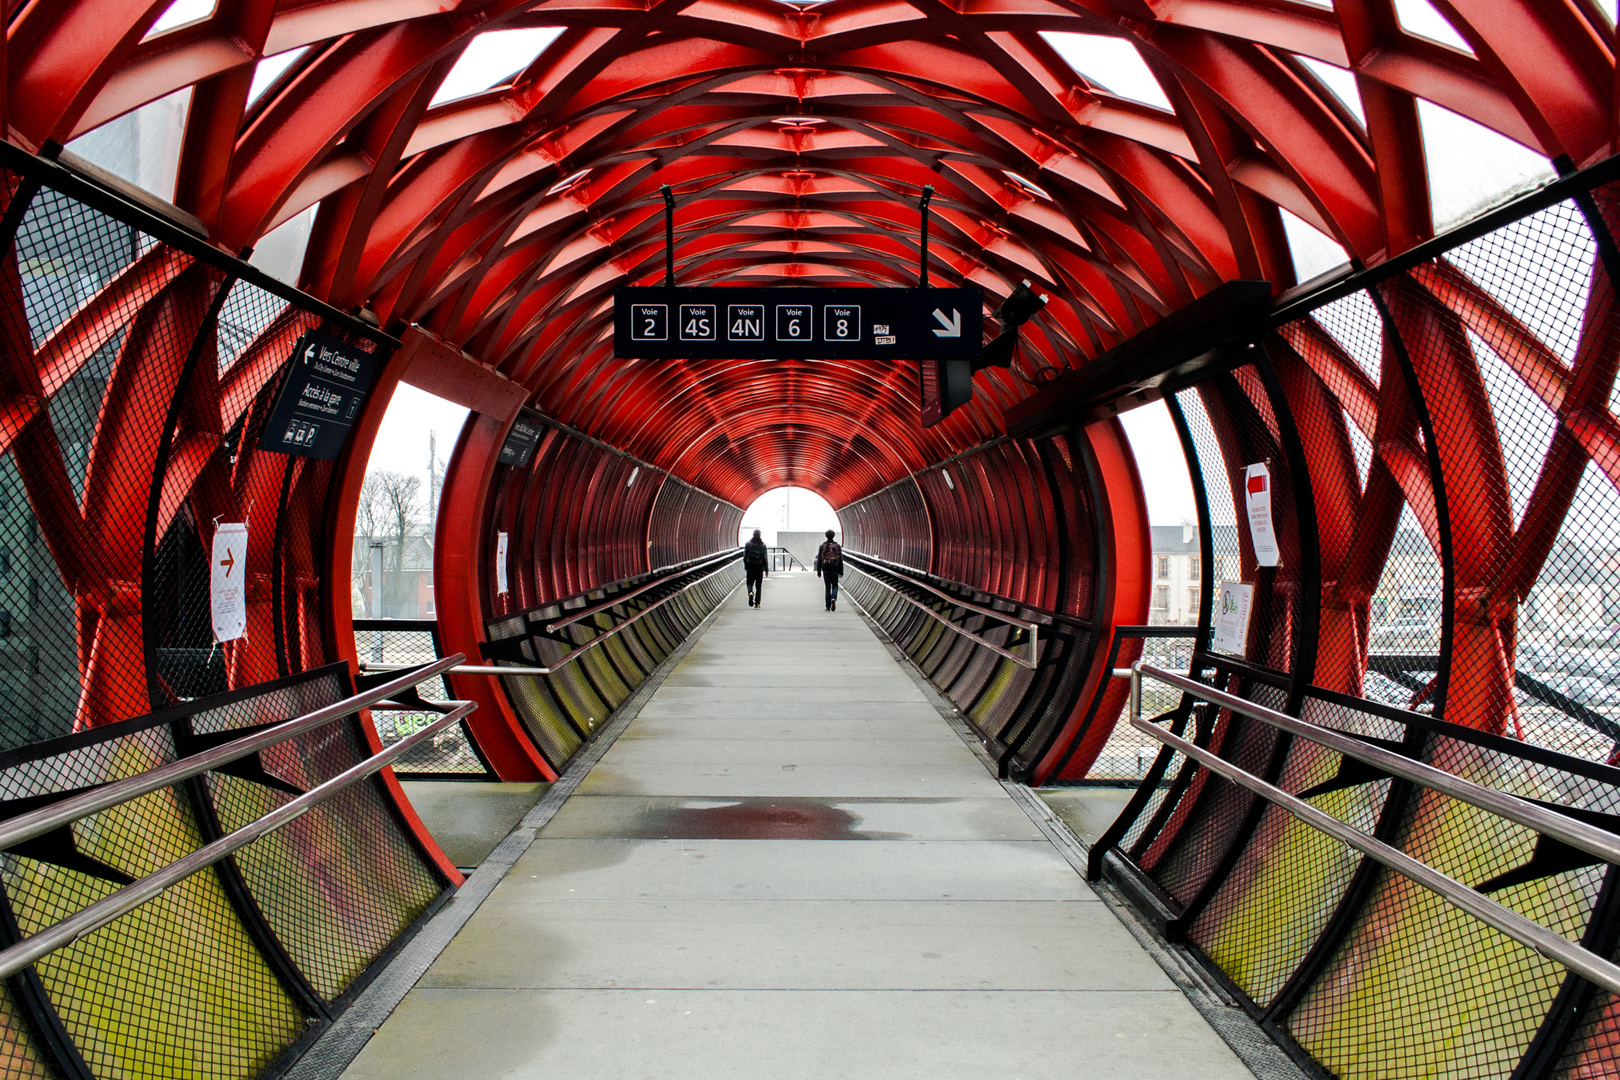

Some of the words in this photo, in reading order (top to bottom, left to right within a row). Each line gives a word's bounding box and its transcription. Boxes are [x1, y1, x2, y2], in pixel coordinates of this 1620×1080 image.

[641, 308, 658, 316] Voie
[690, 308, 706, 316] Voie
[738, 308, 754, 316] Voie
[644, 318, 656, 337] 2
[685, 318, 711, 337] 4S
[731, 318, 760, 337] 4N
[788, 318, 801, 337] 6
[836, 319, 849, 337] 8
[319, 345, 333, 363] Vers
[331, 351, 350, 369] Centre
[302, 382, 321, 400] Accès
[323, 388, 331, 402] la
[327, 393, 342, 407] gare
[305, 427, 316, 443] P
